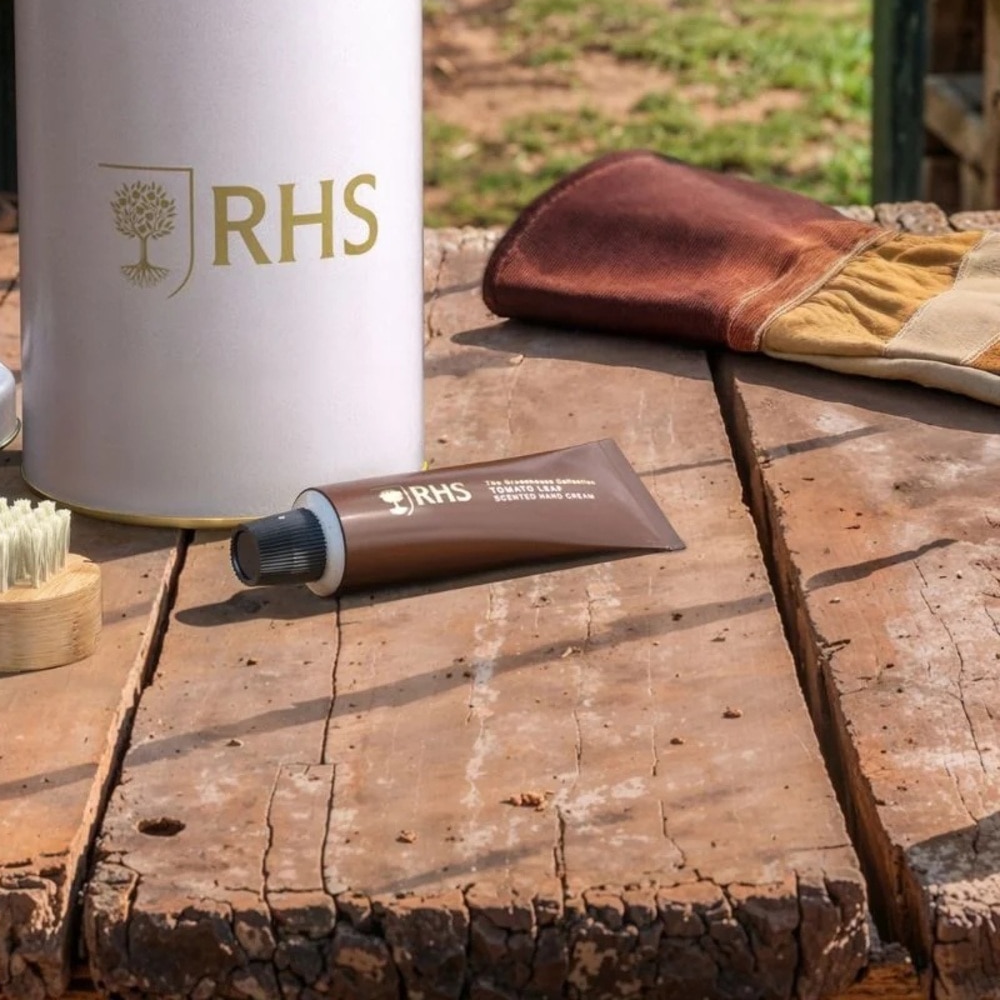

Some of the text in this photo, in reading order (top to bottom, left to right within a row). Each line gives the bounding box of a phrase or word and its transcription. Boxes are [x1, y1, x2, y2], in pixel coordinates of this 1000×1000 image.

[211, 173, 379, 266] RHS
[409, 482, 472, 505] RHS
[489, 484, 535, 494] TOMATO
[493, 492, 596, 503] SCENTED HAND CREAM
